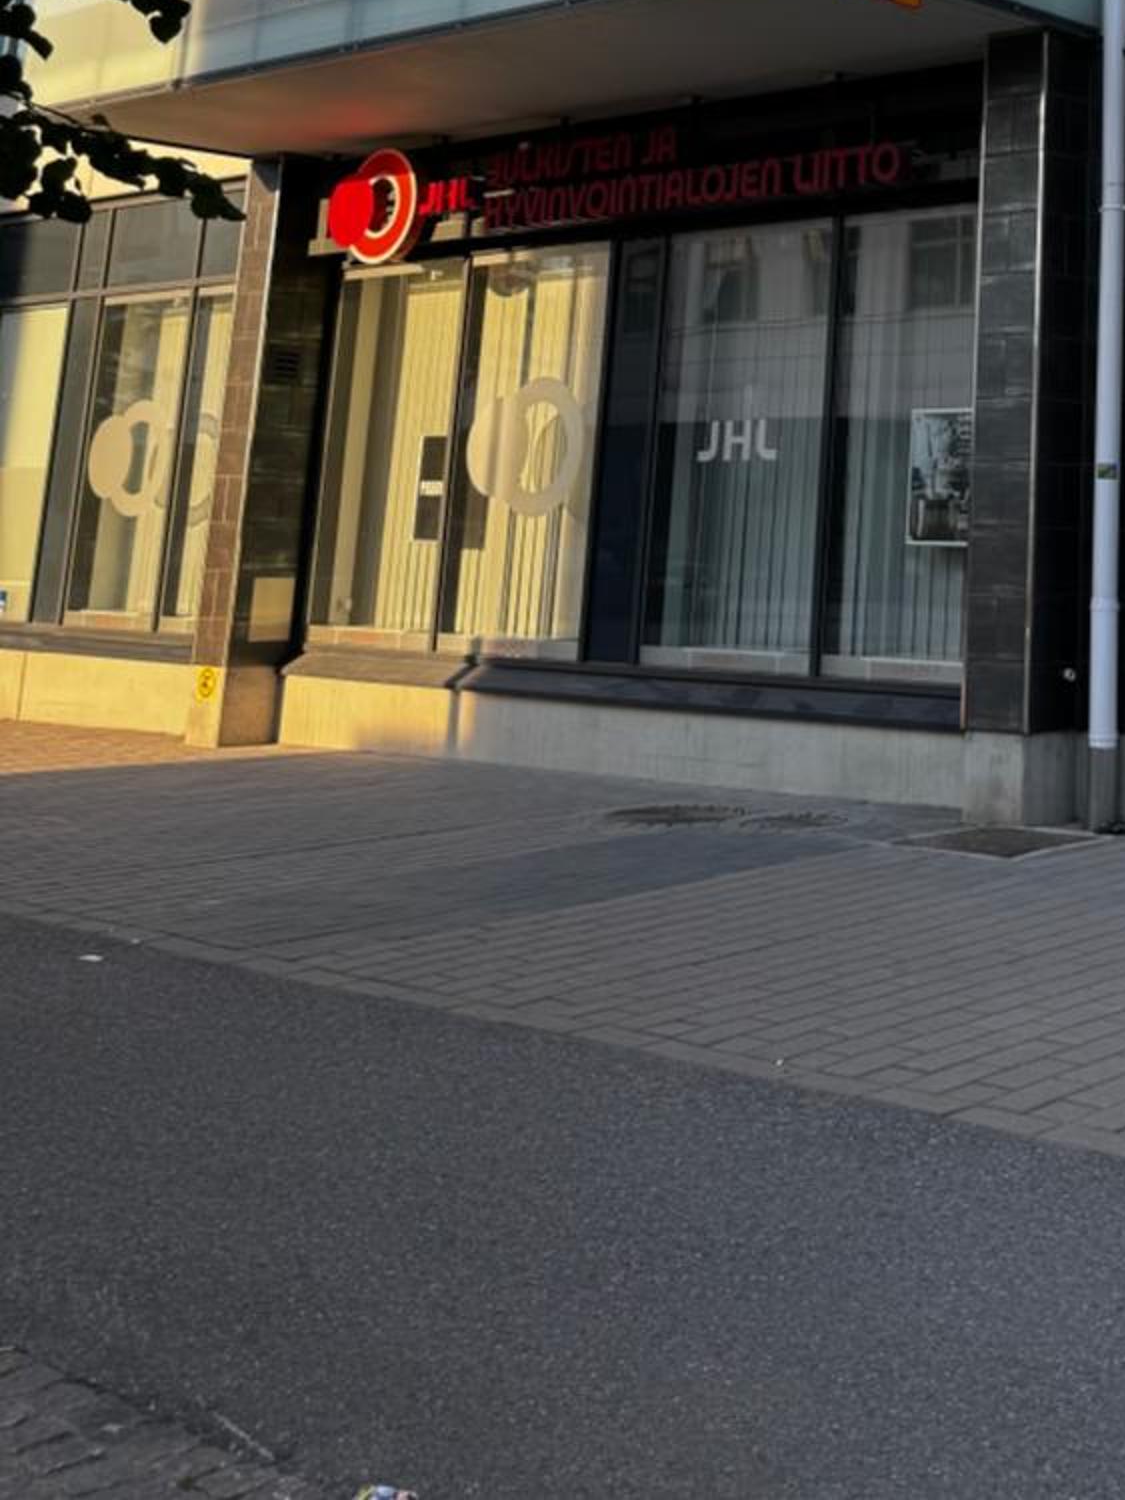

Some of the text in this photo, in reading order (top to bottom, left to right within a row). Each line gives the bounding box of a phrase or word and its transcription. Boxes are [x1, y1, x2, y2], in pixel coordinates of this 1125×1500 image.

[641, 123, 678, 164] JA
[791, 142, 901, 195] LIITTO
[419, 176, 477, 215] JHL
[696, 419, 778, 462] JHL
